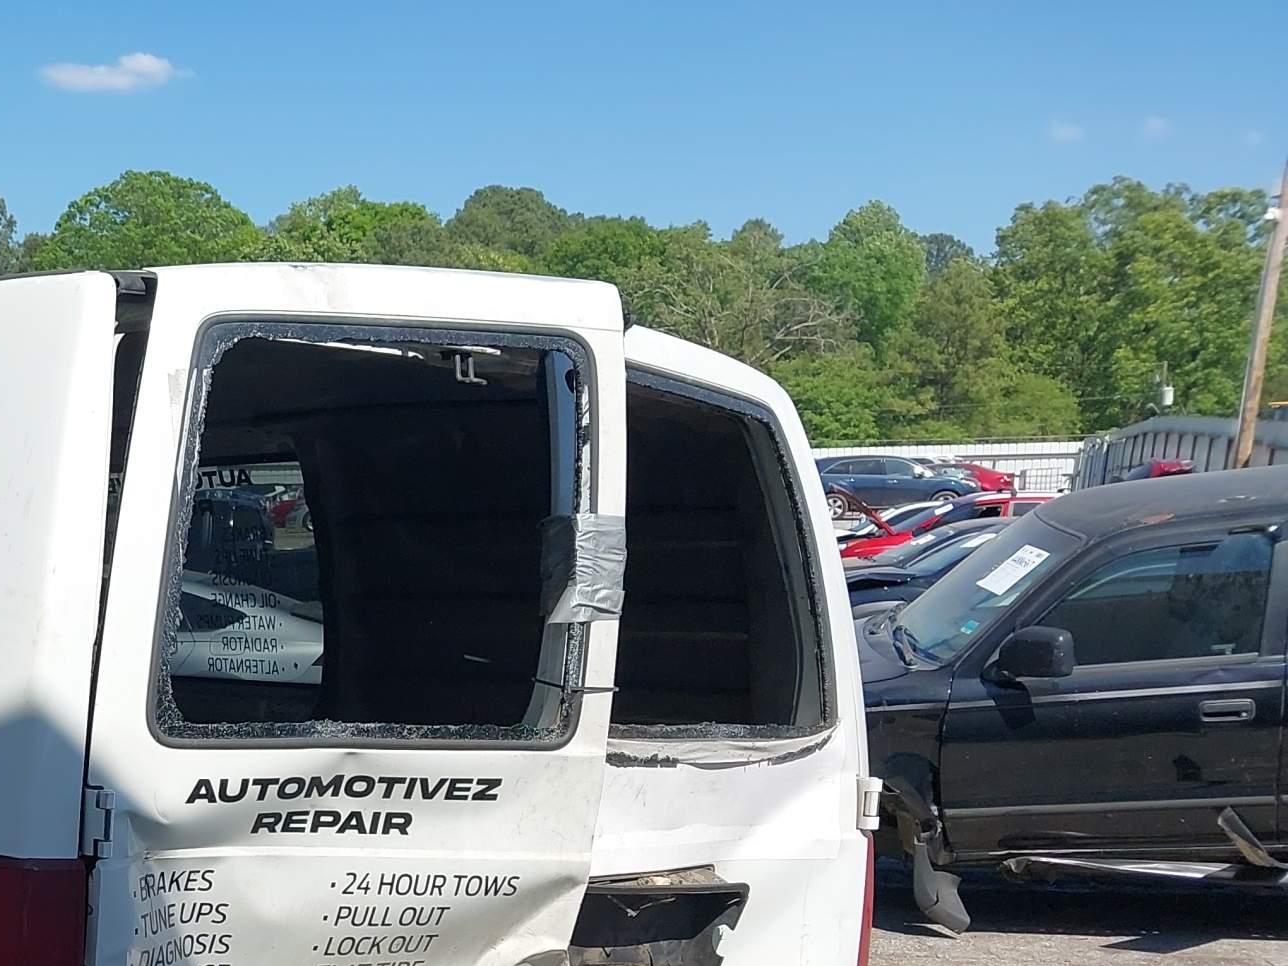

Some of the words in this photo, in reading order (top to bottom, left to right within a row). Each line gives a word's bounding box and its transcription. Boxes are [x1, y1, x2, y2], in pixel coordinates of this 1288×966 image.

[185, 774, 502, 804] AUTOMOTIVEZ
[250, 810, 413, 835] REPAIR
[139, 869, 215, 901] BRAKES
[341, 872, 370, 895] 24
[377, 873, 446, 896] HOUR
[454, 875, 520, 897] TOWS
[141, 903, 176, 938] TUNE
[179, 902, 229, 924] UPS
[333, 906, 393, 927] PULL
[398, 906, 450, 926] OUT
[323, 936, 387, 956] LOCK
[388, 934, 439, 954] OUT
